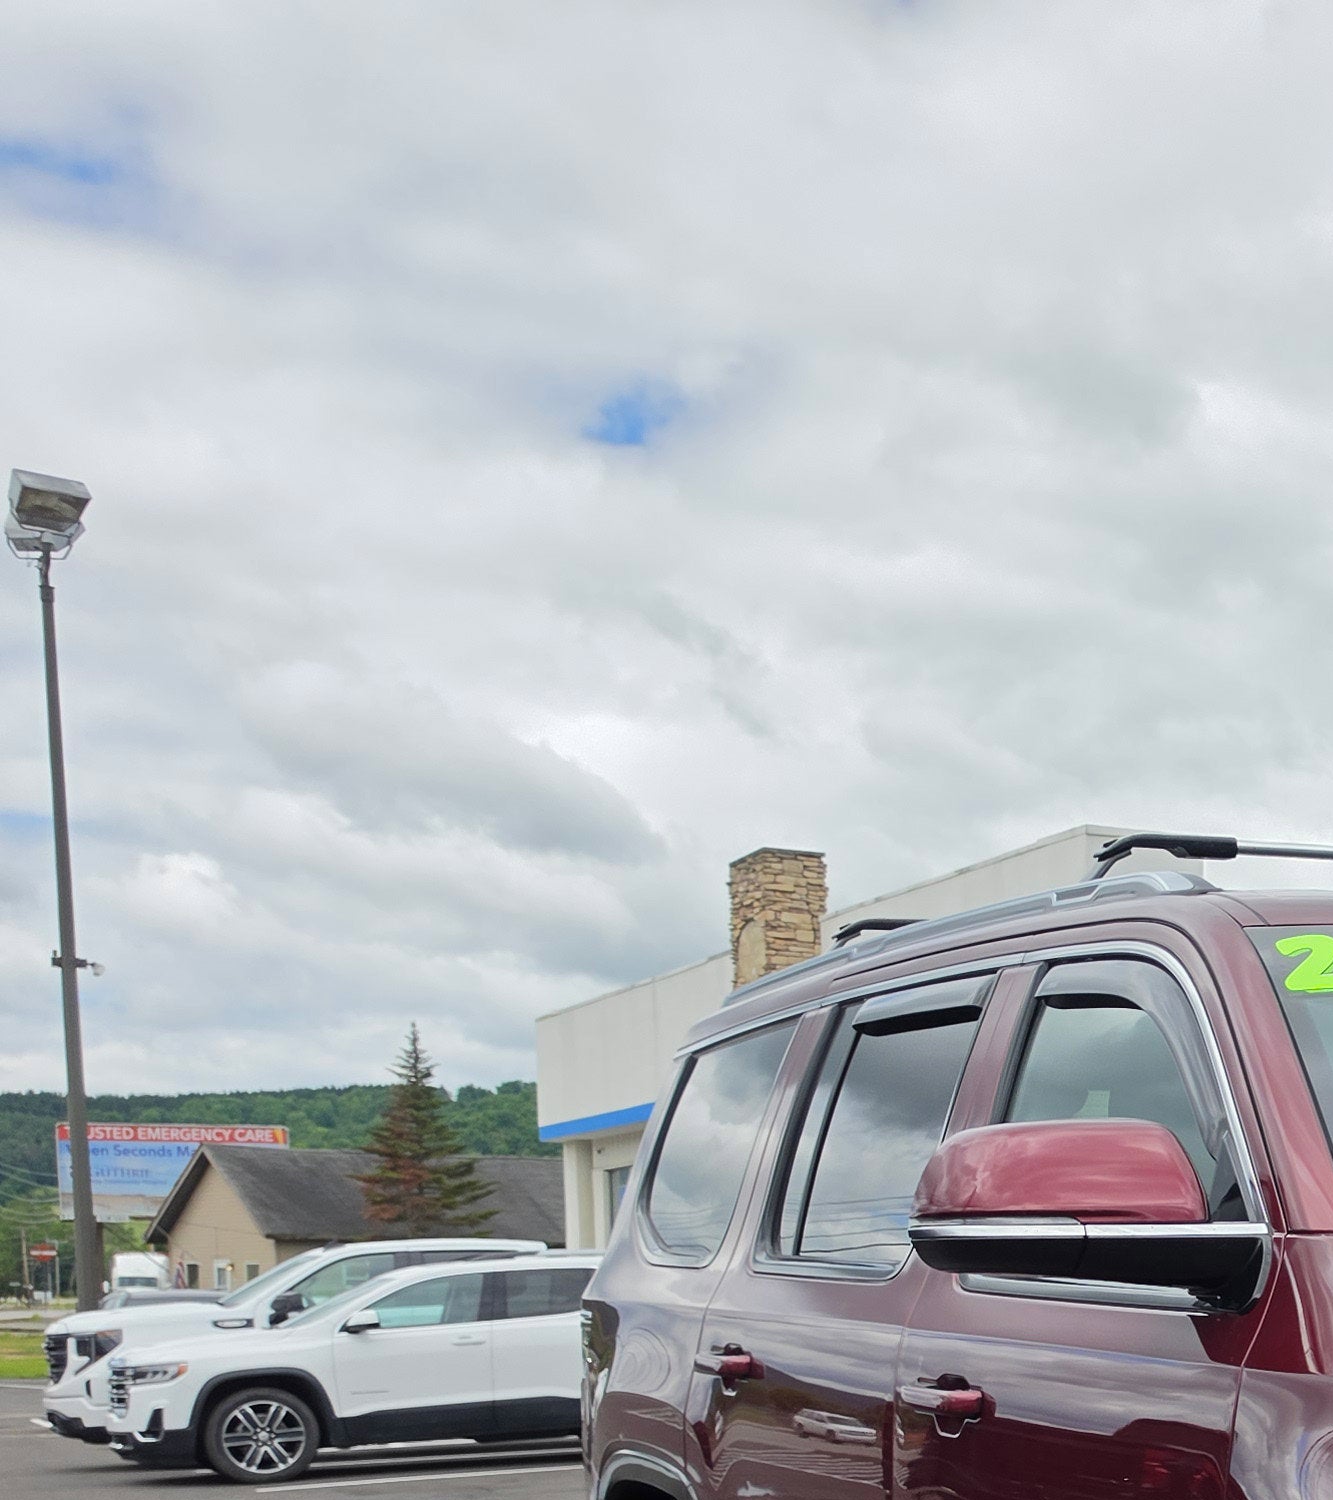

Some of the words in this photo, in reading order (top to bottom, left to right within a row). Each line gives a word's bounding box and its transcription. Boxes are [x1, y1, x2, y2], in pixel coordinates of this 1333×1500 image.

[64, 1126, 133, 1141] TUSTED
[138, 1126, 233, 1142] EMERGENCY
[234, 1128, 274, 1143] CARE
[115, 1144, 173, 1157] Seconds
